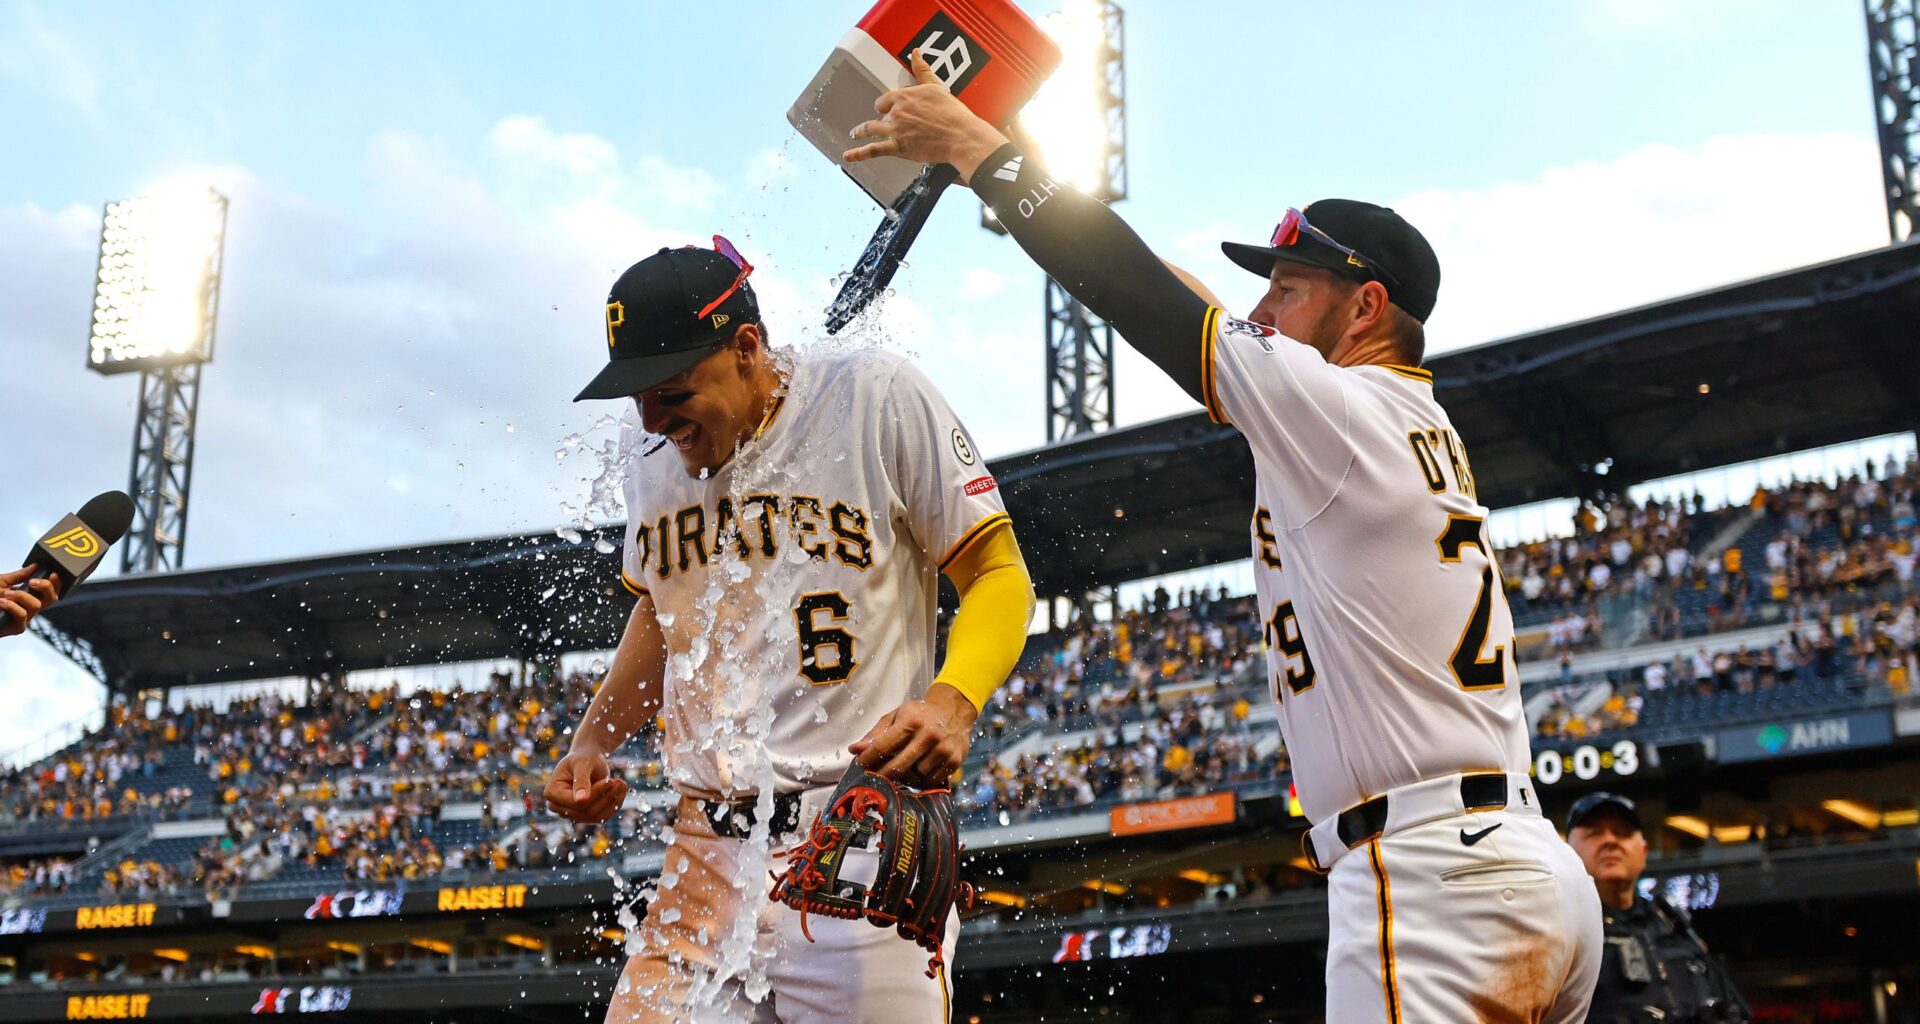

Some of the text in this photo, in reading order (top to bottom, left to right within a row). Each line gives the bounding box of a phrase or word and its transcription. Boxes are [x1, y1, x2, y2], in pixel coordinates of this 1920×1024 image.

[606, 300, 625, 347] P
[956, 435, 971, 458] 9
[965, 478, 997, 494] SHEETZ
[792, 589, 860, 686] 6
[1790, 717, 1849, 750] AHN
[897, 810, 917, 875] marucci
[437, 883, 528, 911] RAISE IT
[76, 903, 157, 929] RAISE IT
[66, 993, 151, 1020] RAISE IT
